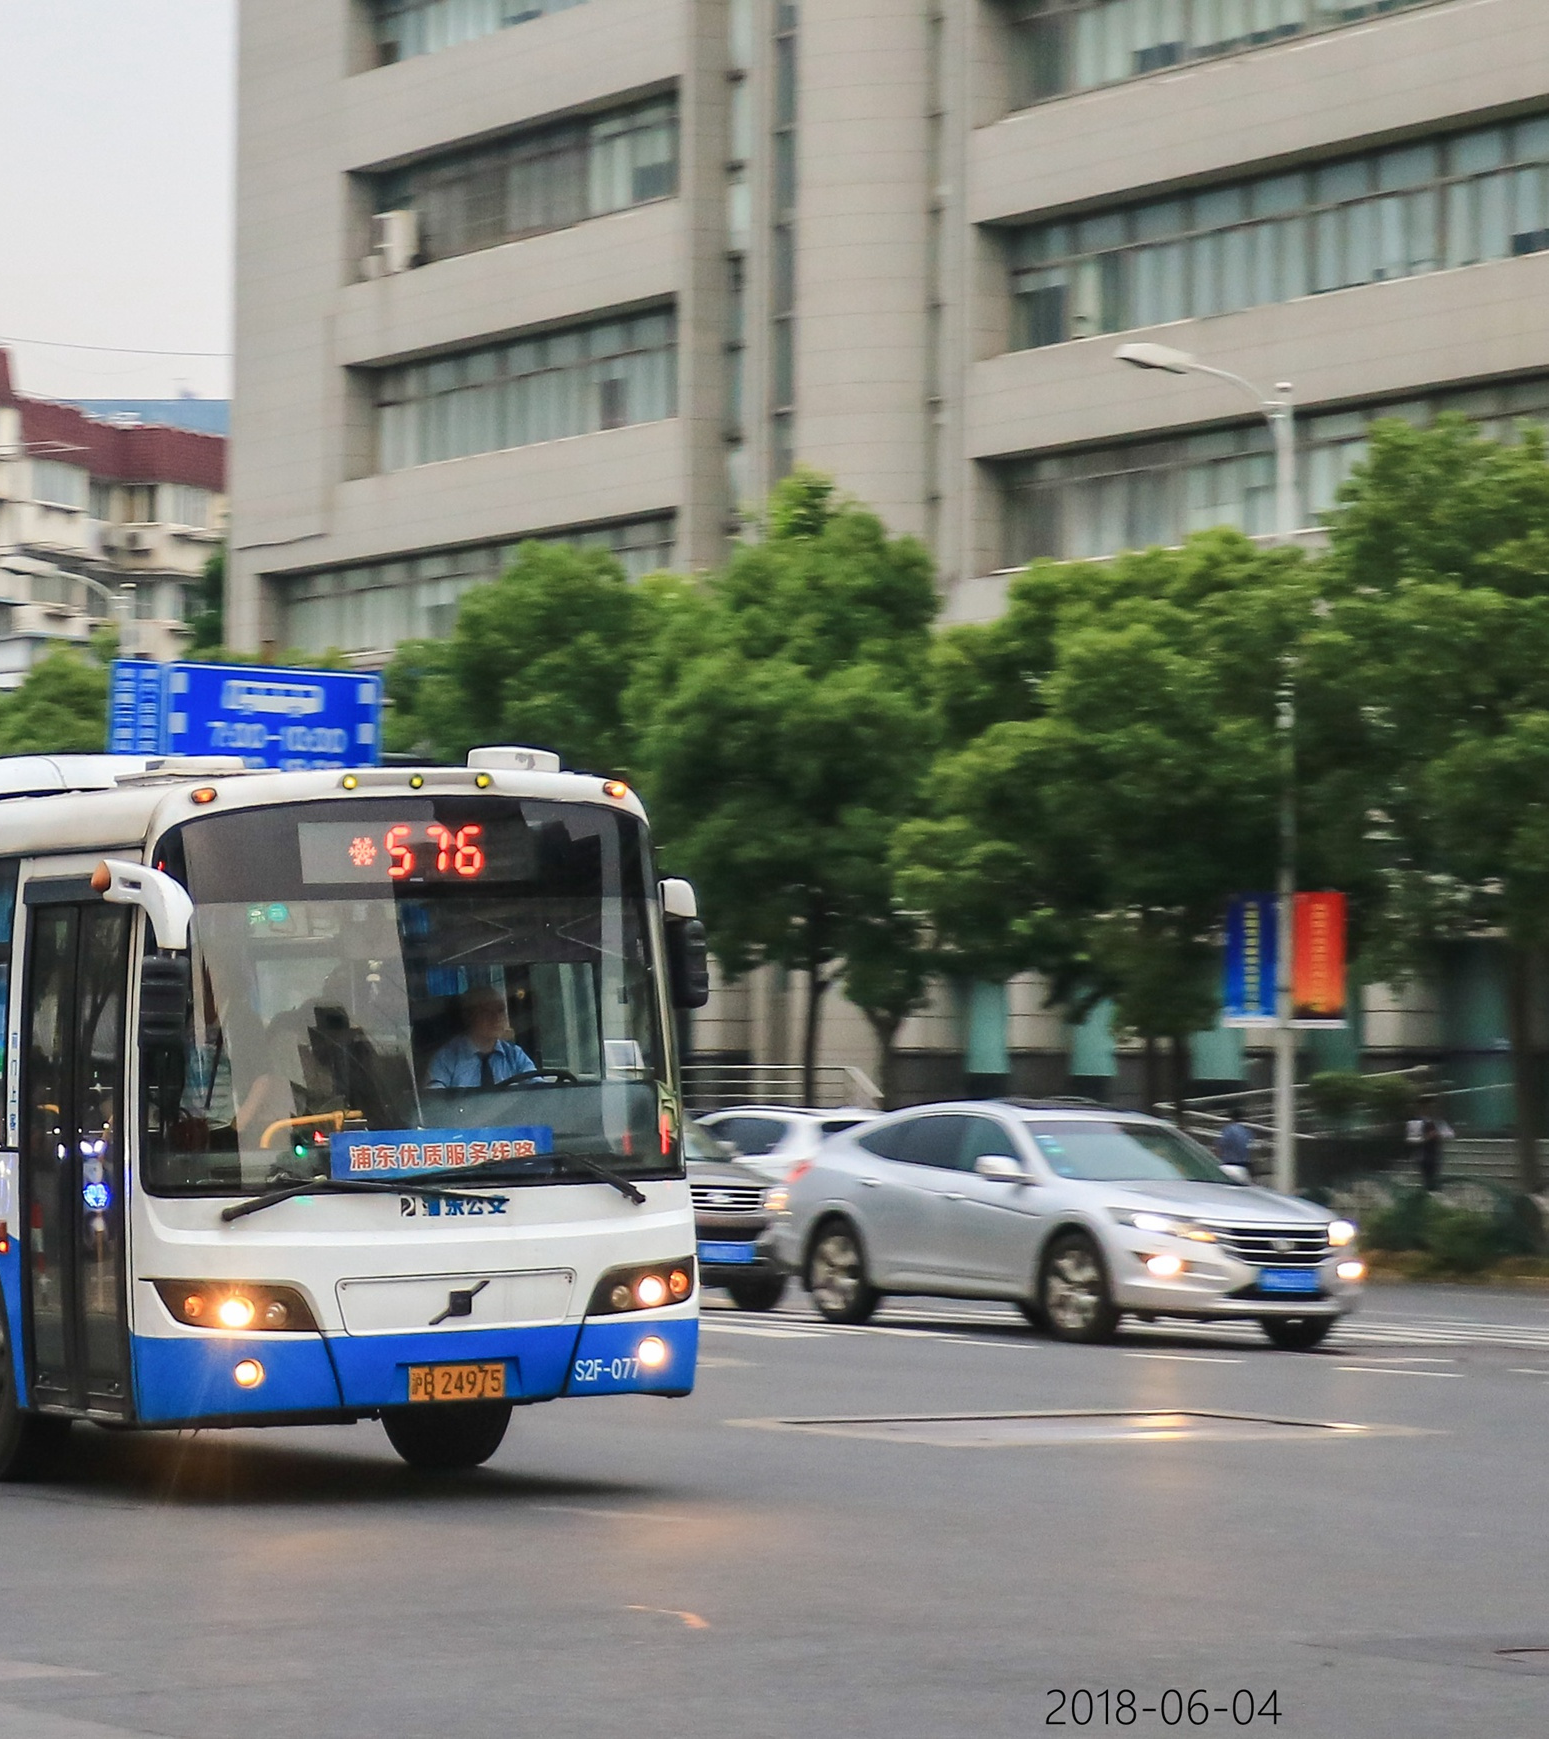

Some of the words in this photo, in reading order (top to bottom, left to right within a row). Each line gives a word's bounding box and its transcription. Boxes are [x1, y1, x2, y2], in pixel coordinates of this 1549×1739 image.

[384, 824, 484, 878] 576
[349, 1139, 537, 1171] 浦东优质服务线路
[574, 1358, 640, 1382] S2F-077
